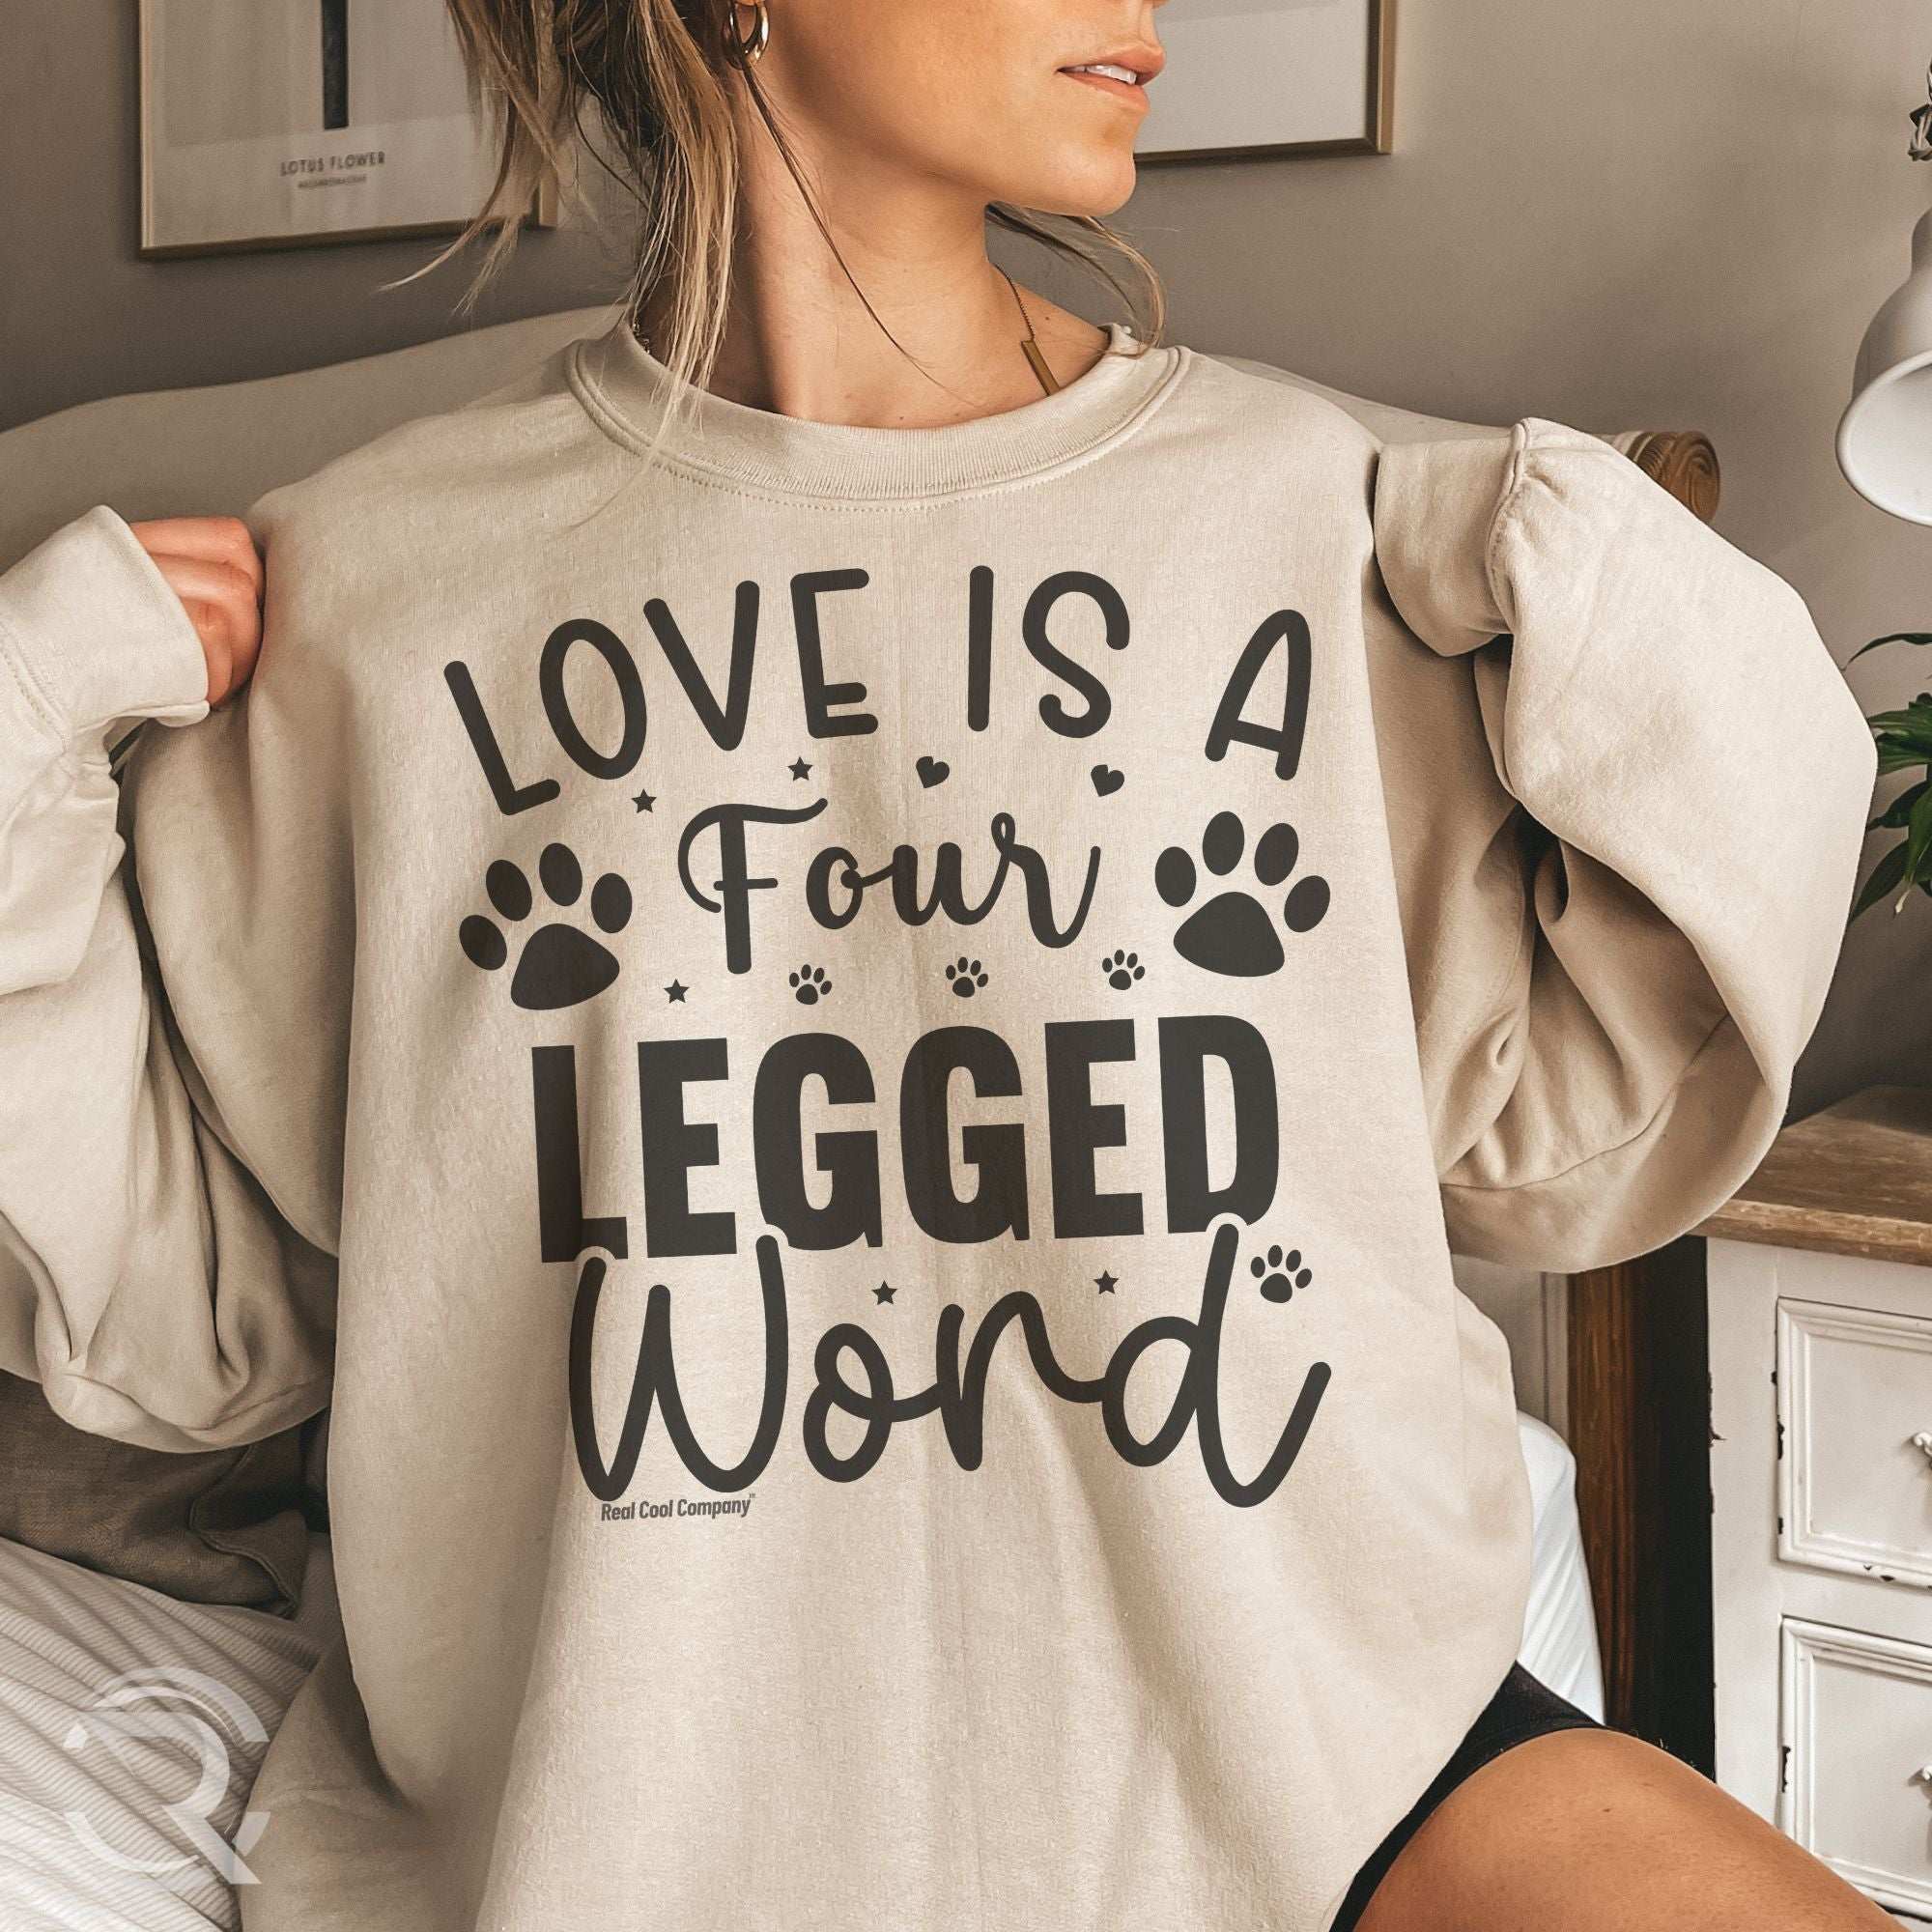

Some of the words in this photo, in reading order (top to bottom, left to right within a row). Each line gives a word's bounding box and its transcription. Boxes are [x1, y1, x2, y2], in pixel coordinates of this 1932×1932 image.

[280, 157, 325, 177] LOTUS
[329, 151, 385, 171] FLOWER
[443, 568, 879, 816] LOVE
[967, 565, 1130, 739] IS
[1205, 609, 1312, 781] A
[677, 798, 1101, 975] Four
[531, 1014, 1280, 1264] LEGGED
[568, 1223, 1332, 1508] Word
[601, 1501, 635, 1521] Real
[639, 1499, 674, 1519] Cool
